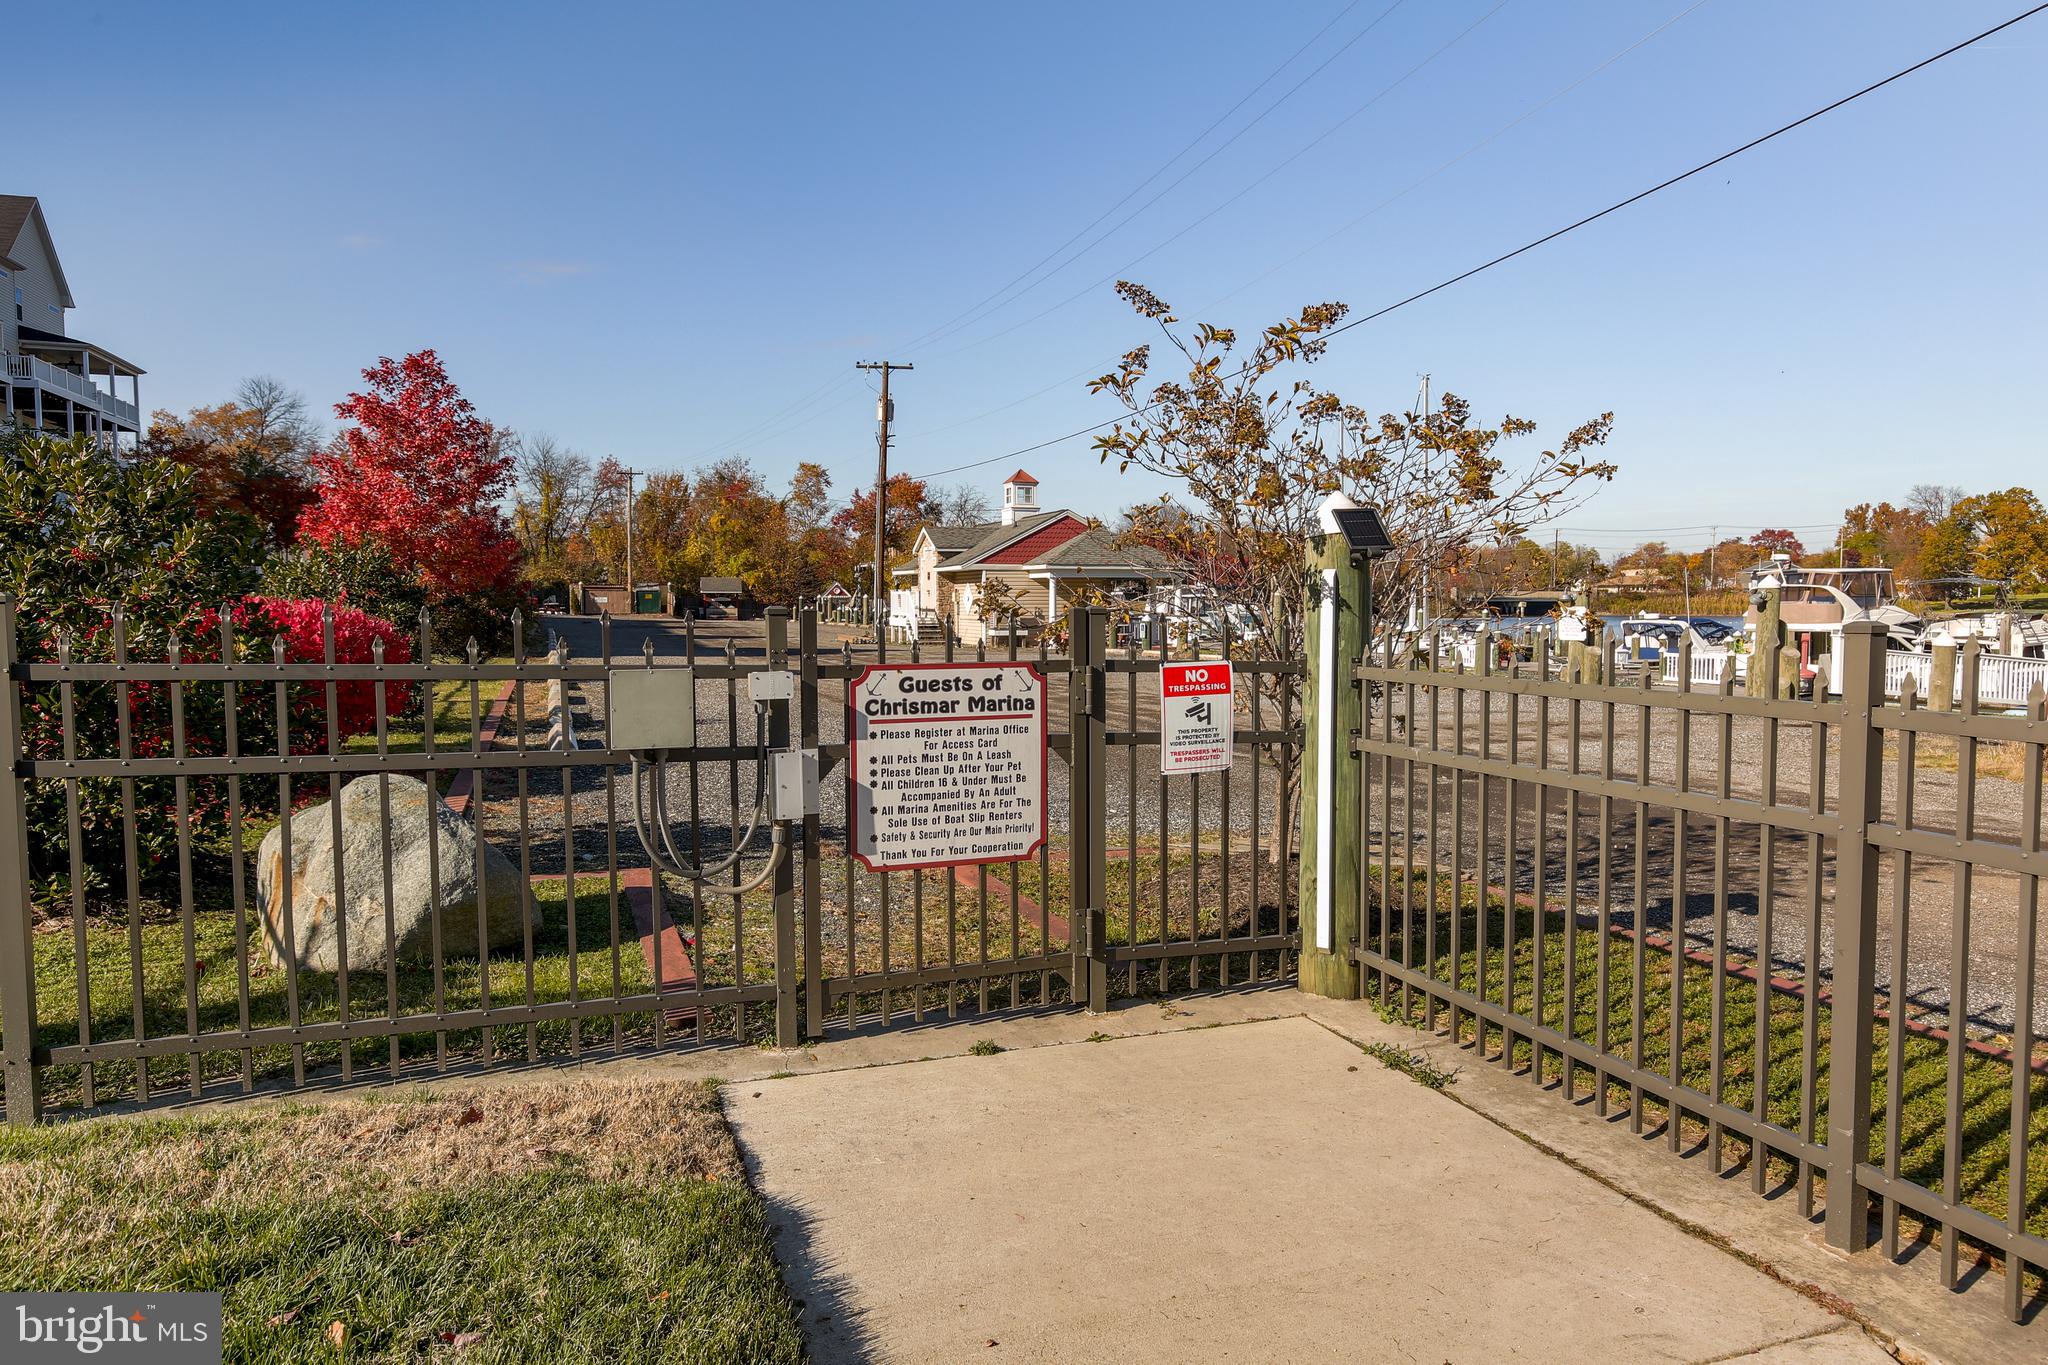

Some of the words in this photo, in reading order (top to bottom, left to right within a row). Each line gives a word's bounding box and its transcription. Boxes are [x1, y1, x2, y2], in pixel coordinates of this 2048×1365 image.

[898, 676, 973, 693] Guests
[982, 674, 1003, 691] of
[1185, 669, 1208, 682] NO
[1168, 683, 1226, 692] TRESPASSING
[865, 698, 960, 716] Chrismar
[968, 695, 1035, 712] Marina
[880, 729, 910, 739] Please
[914, 727, 952, 738] Register
[957, 727, 965, 736] at
[969, 726, 999, 736] Marina
[1003, 725, 1029, 734] Office
[924, 741, 938, 750] For
[942, 740, 974, 749] Access
[978, 738, 997, 748] Card
[881, 755, 893, 764] All
[898, 754, 917, 764] Pets
[922, 753, 943, 763] Must
[948, 753, 958, 761] Be
[962, 752, 973, 761] On
[977, 752, 982, 760] A
[987, 750, 1011, 760] Leash
[881, 768, 910, 778] Please
[915, 766, 939, 776] Clean
[943, 765, 954, 776] Up
[958, 764, 980, 774] After
[985, 763, 1004, 772] Your
[1008, 762, 1021, 771] Pet
[881, 780, 893, 790] All
[898, 779, 934, 789] Children
[938, 778, 947, 787] 16
[952, 778, 958, 786] &
[962, 776, 987, 785] Under
[991, 775, 1012, 784] Must
[1016, 774, 1026, 783] Be
[901, 791, 960, 802] Accompanied
[965, 790, 974, 801] By
[979, 789, 990, 797] An
[994, 787, 1016, 796] Adult
[882, 806, 893, 816] All
[898, 804, 928, 815] Marina
[933, 802, 976, 813] Amenities
[981, 801, 996, 809] Are
[1000, 800, 1012, 808] For
[1016, 798, 1031, 807] The
[888, 818, 908, 828] Sole
[912, 817, 928, 826] Use
[932, 816, 941, 825] of
[945, 814, 964, 824] Boat
[969, 813, 985, 824] Slip
[989, 812, 1022, 821] Renters
[882, 832, 906, 843] Safety
[910, 832, 915, 840] &
[919, 828, 950, 840] Security
[954, 828, 966, 838] Are
[970, 827, 981, 836] Our
[985, 825, 1002, 834] Main
[1005, 823, 1034, 834] Priority!
[880, 850, 907, 860] Thank
[912, 849, 927, 858] You
[931, 848, 944, 857] For
[948, 846, 968, 855] Your
[972, 842, 1023, 854] Cooperation
